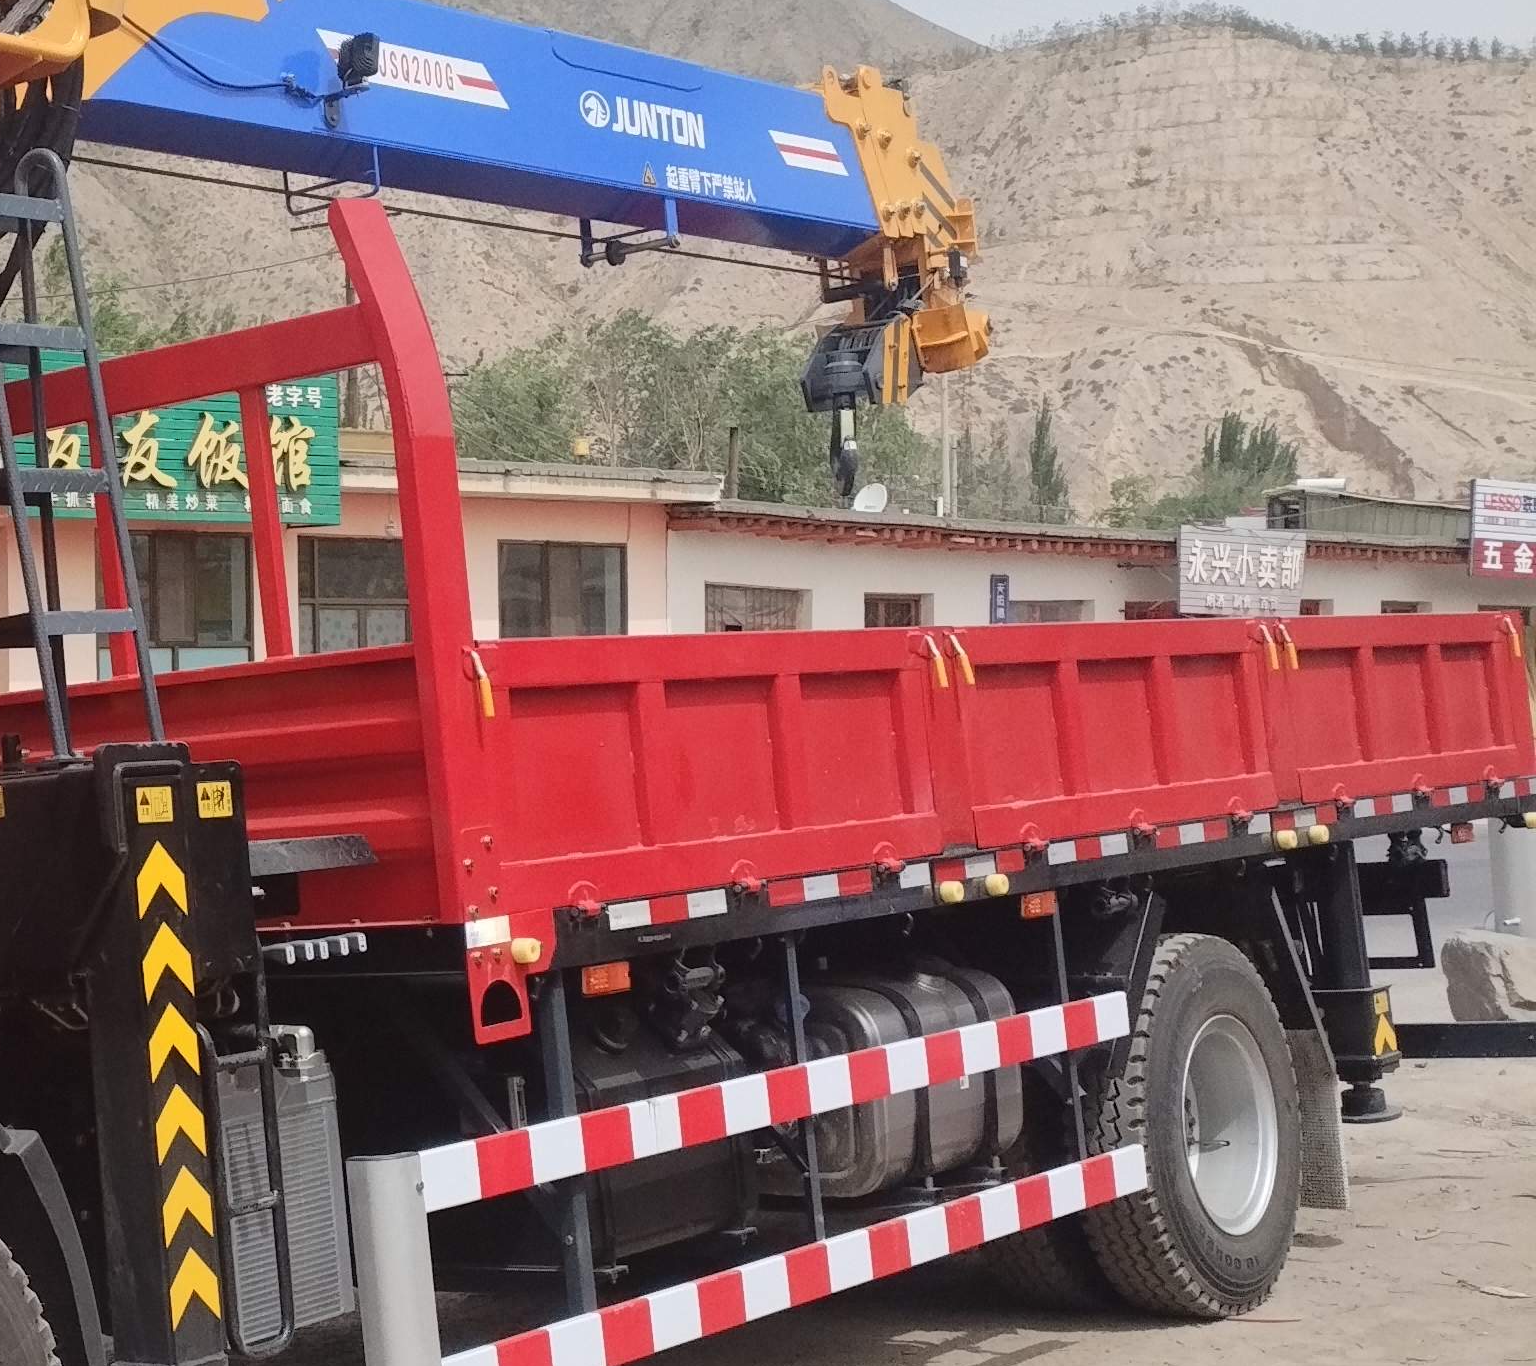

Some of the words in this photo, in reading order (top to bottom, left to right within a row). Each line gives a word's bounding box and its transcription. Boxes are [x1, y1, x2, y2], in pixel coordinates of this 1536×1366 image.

[379, 57, 455, 92] JSQ200G
[611, 96, 706, 150] JUNTON
[665, 163, 757, 204] 起重臂下严禁站人
[265, 384, 323, 409] 老字号
[145, 492, 218, 512] 精美炒菜
[1186, 538, 1304, 590] 永兴小卖部
[1482, 540, 1534, 574] 五金
